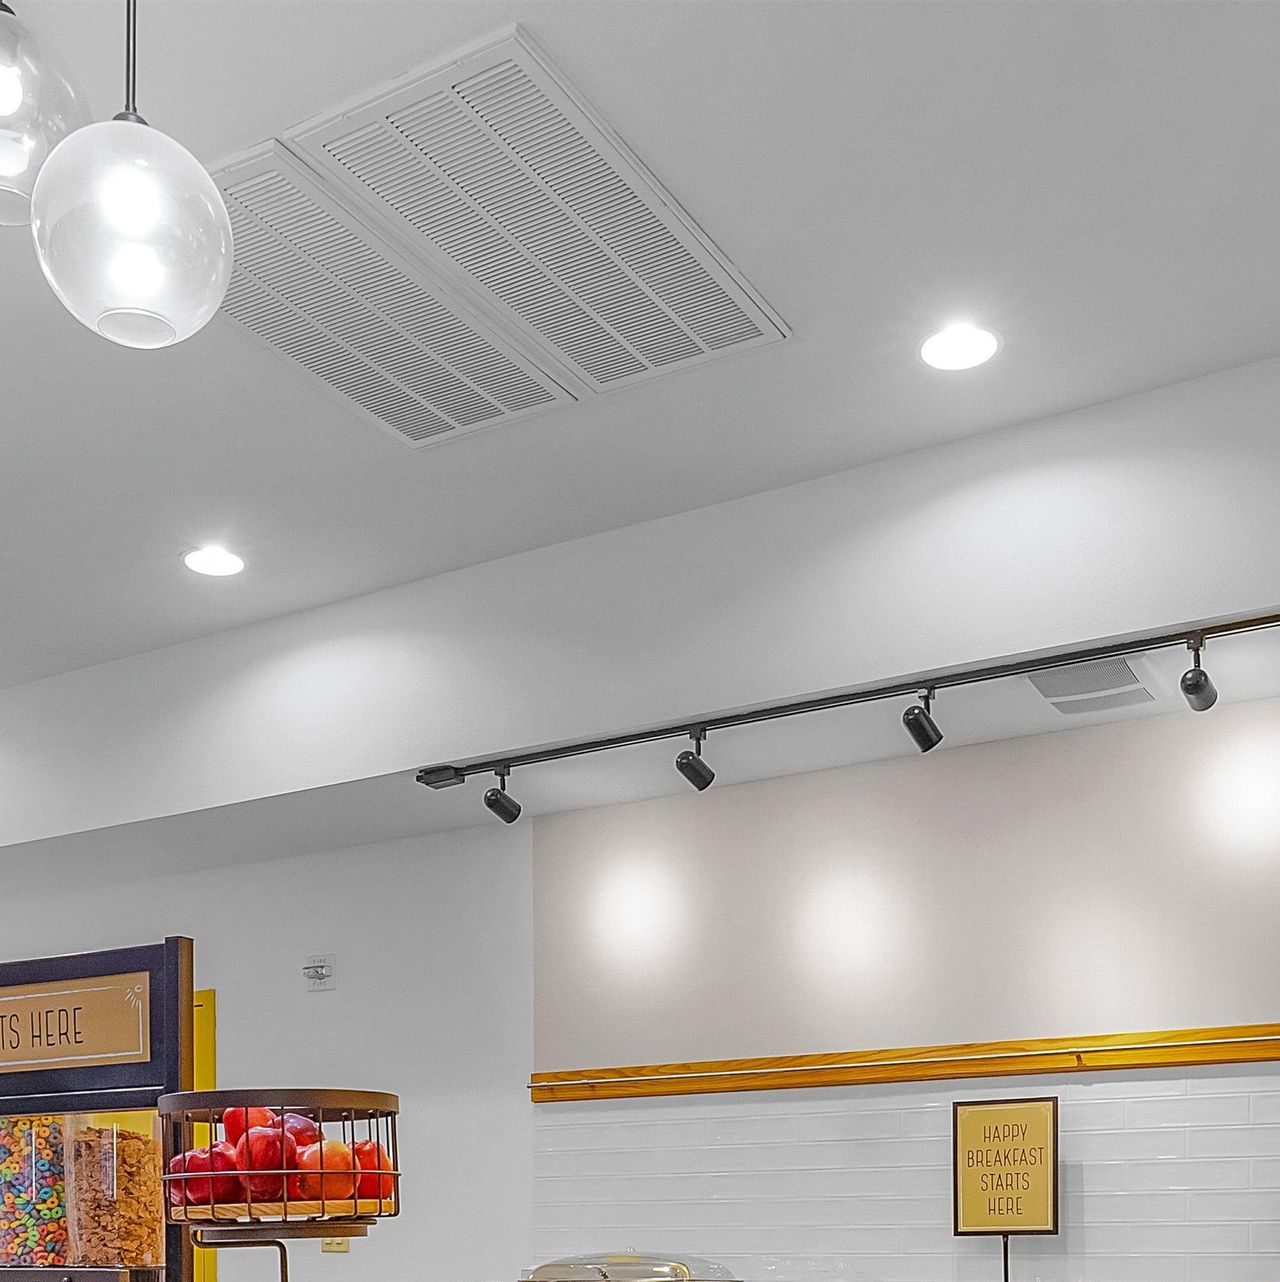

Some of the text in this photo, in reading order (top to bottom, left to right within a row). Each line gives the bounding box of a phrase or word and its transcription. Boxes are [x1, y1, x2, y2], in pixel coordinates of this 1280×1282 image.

[30, 1006, 84, 1048] HERE
[983, 1123, 1028, 1143] HAPPY
[967, 1146, 1045, 1168] BREAKFAST
[980, 1171, 1030, 1192] STARTS
[988, 1196, 1023, 1216] HERE
